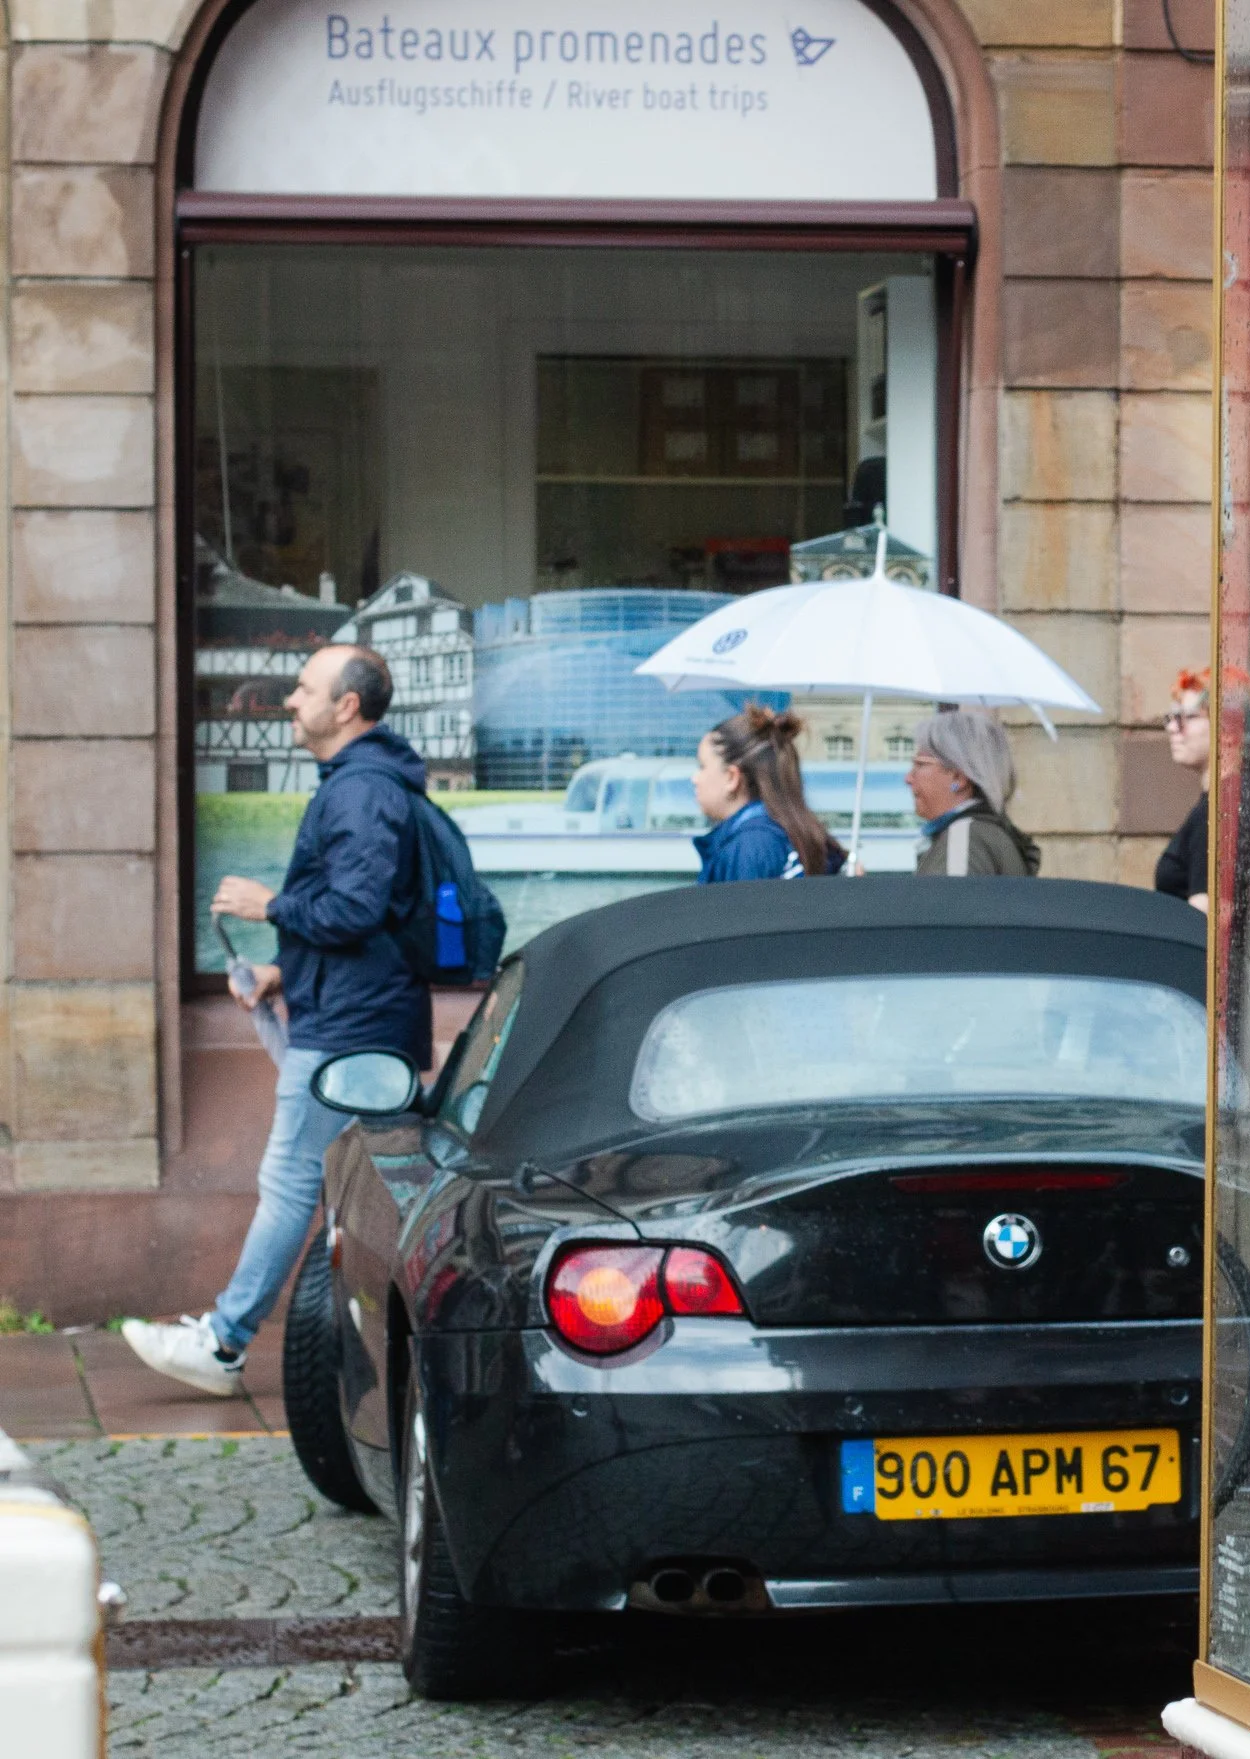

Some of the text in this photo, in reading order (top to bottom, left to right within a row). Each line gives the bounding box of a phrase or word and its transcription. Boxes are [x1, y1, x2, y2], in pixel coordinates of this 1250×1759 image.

[327, 14, 767, 74] Bateaux promenades
[328, 78, 768, 118] Ausflugsschiffe / River boat trips
[853, 1486, 863, 1501] F
[877, 1444, 1161, 1499] 900 APM 67
